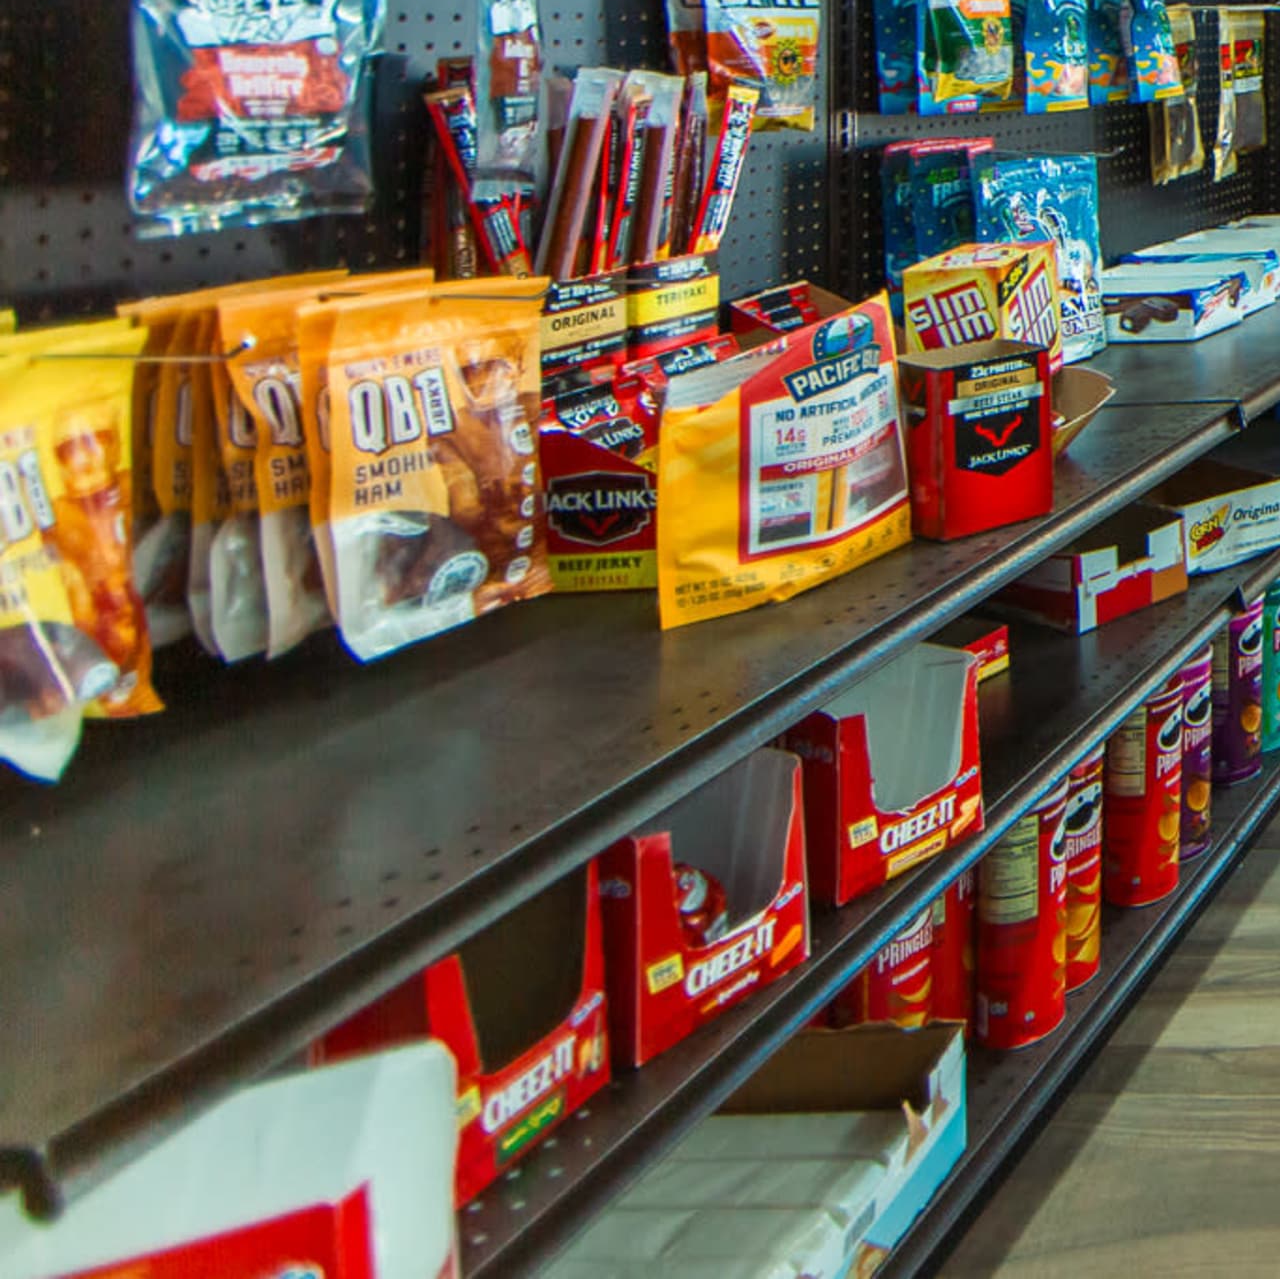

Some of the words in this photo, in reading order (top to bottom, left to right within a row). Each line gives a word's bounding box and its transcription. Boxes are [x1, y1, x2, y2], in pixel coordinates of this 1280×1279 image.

[656, 285, 707, 306] TERIYAKI
[551, 305, 617, 332] ORIGINAL
[974, 374, 1021, 392] ORIGINAL
[350, 368, 454, 455] QB1
[774, 408, 795, 423] NO
[782, 446, 855, 473] ORIGINAL
[354, 482, 403, 505] HAM
[542, 489, 596, 514] JACK
[557, 559, 594, 572] BEEF
[596, 557, 642, 570] JERKY
[880, 792, 957, 856] CHEEZ-IT
[685, 917, 778, 998] CHEEZ-IT
[482, 1035, 577, 1136] CHEEZ-IT
